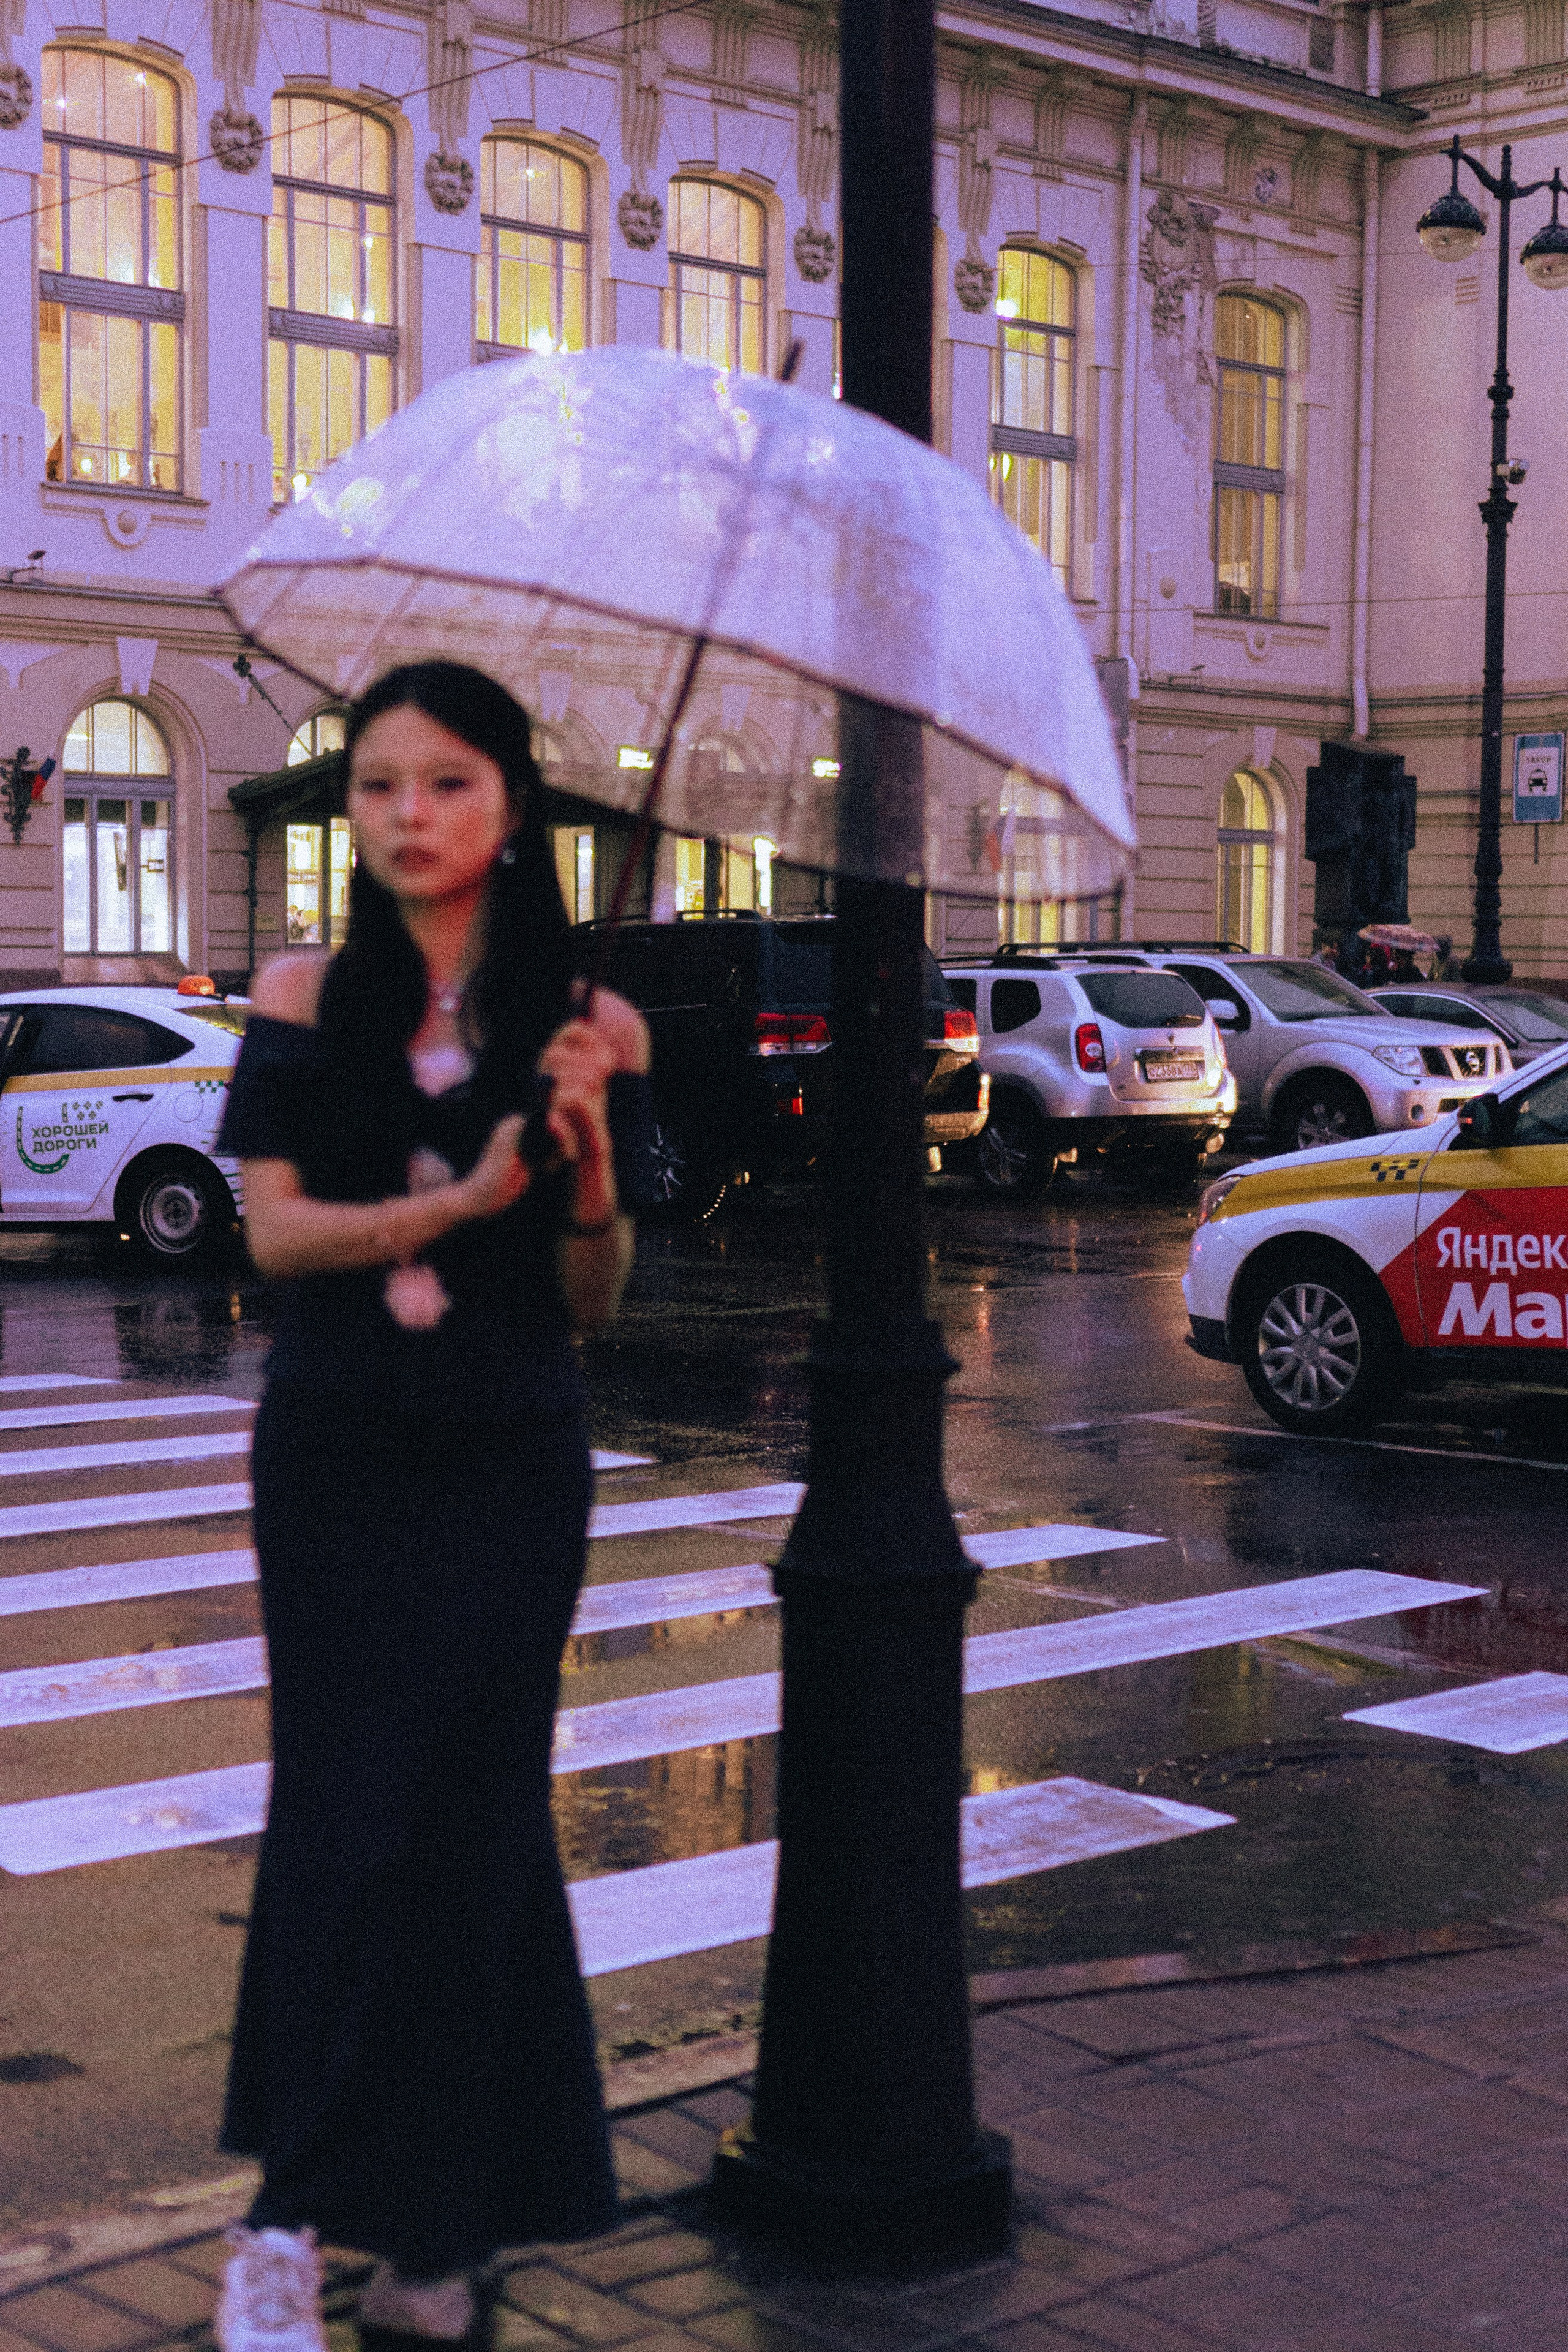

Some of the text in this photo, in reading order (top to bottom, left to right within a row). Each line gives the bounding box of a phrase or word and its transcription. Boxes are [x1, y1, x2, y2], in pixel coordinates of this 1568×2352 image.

[32, 1120, 108, 1138] ХОРОШЕЙ
[34, 1139, 96, 1154] ДОРОГИ
[1438, 1282, 1568, 1345] Ма
